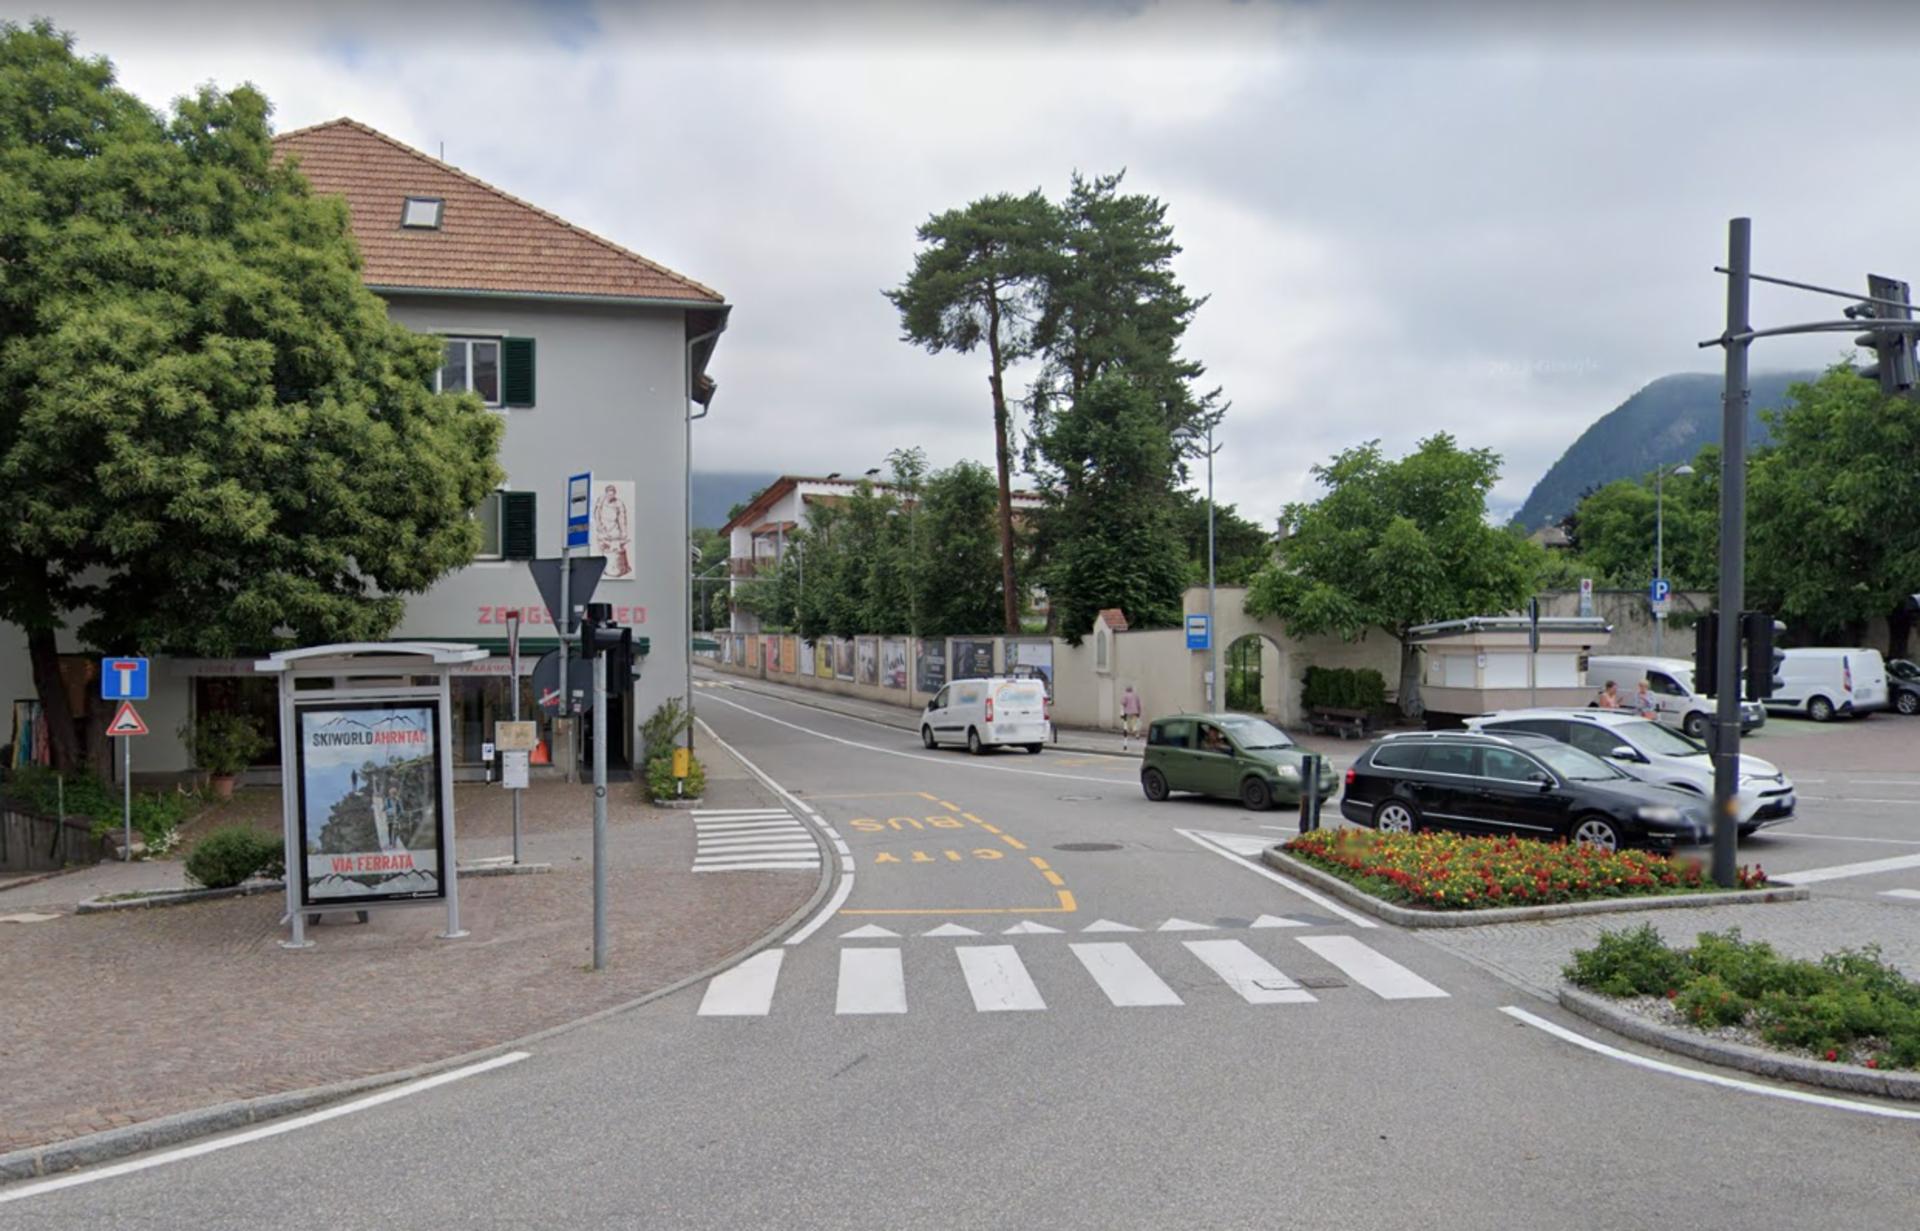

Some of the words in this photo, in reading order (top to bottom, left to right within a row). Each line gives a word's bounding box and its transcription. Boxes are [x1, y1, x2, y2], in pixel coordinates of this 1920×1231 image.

[1656, 581, 1668, 599] P
[851, 816, 965, 832] BUS
[331, 858, 353, 872] VIA
[357, 854, 414, 871] FERRATA
[874, 849, 1004, 863] CITY
